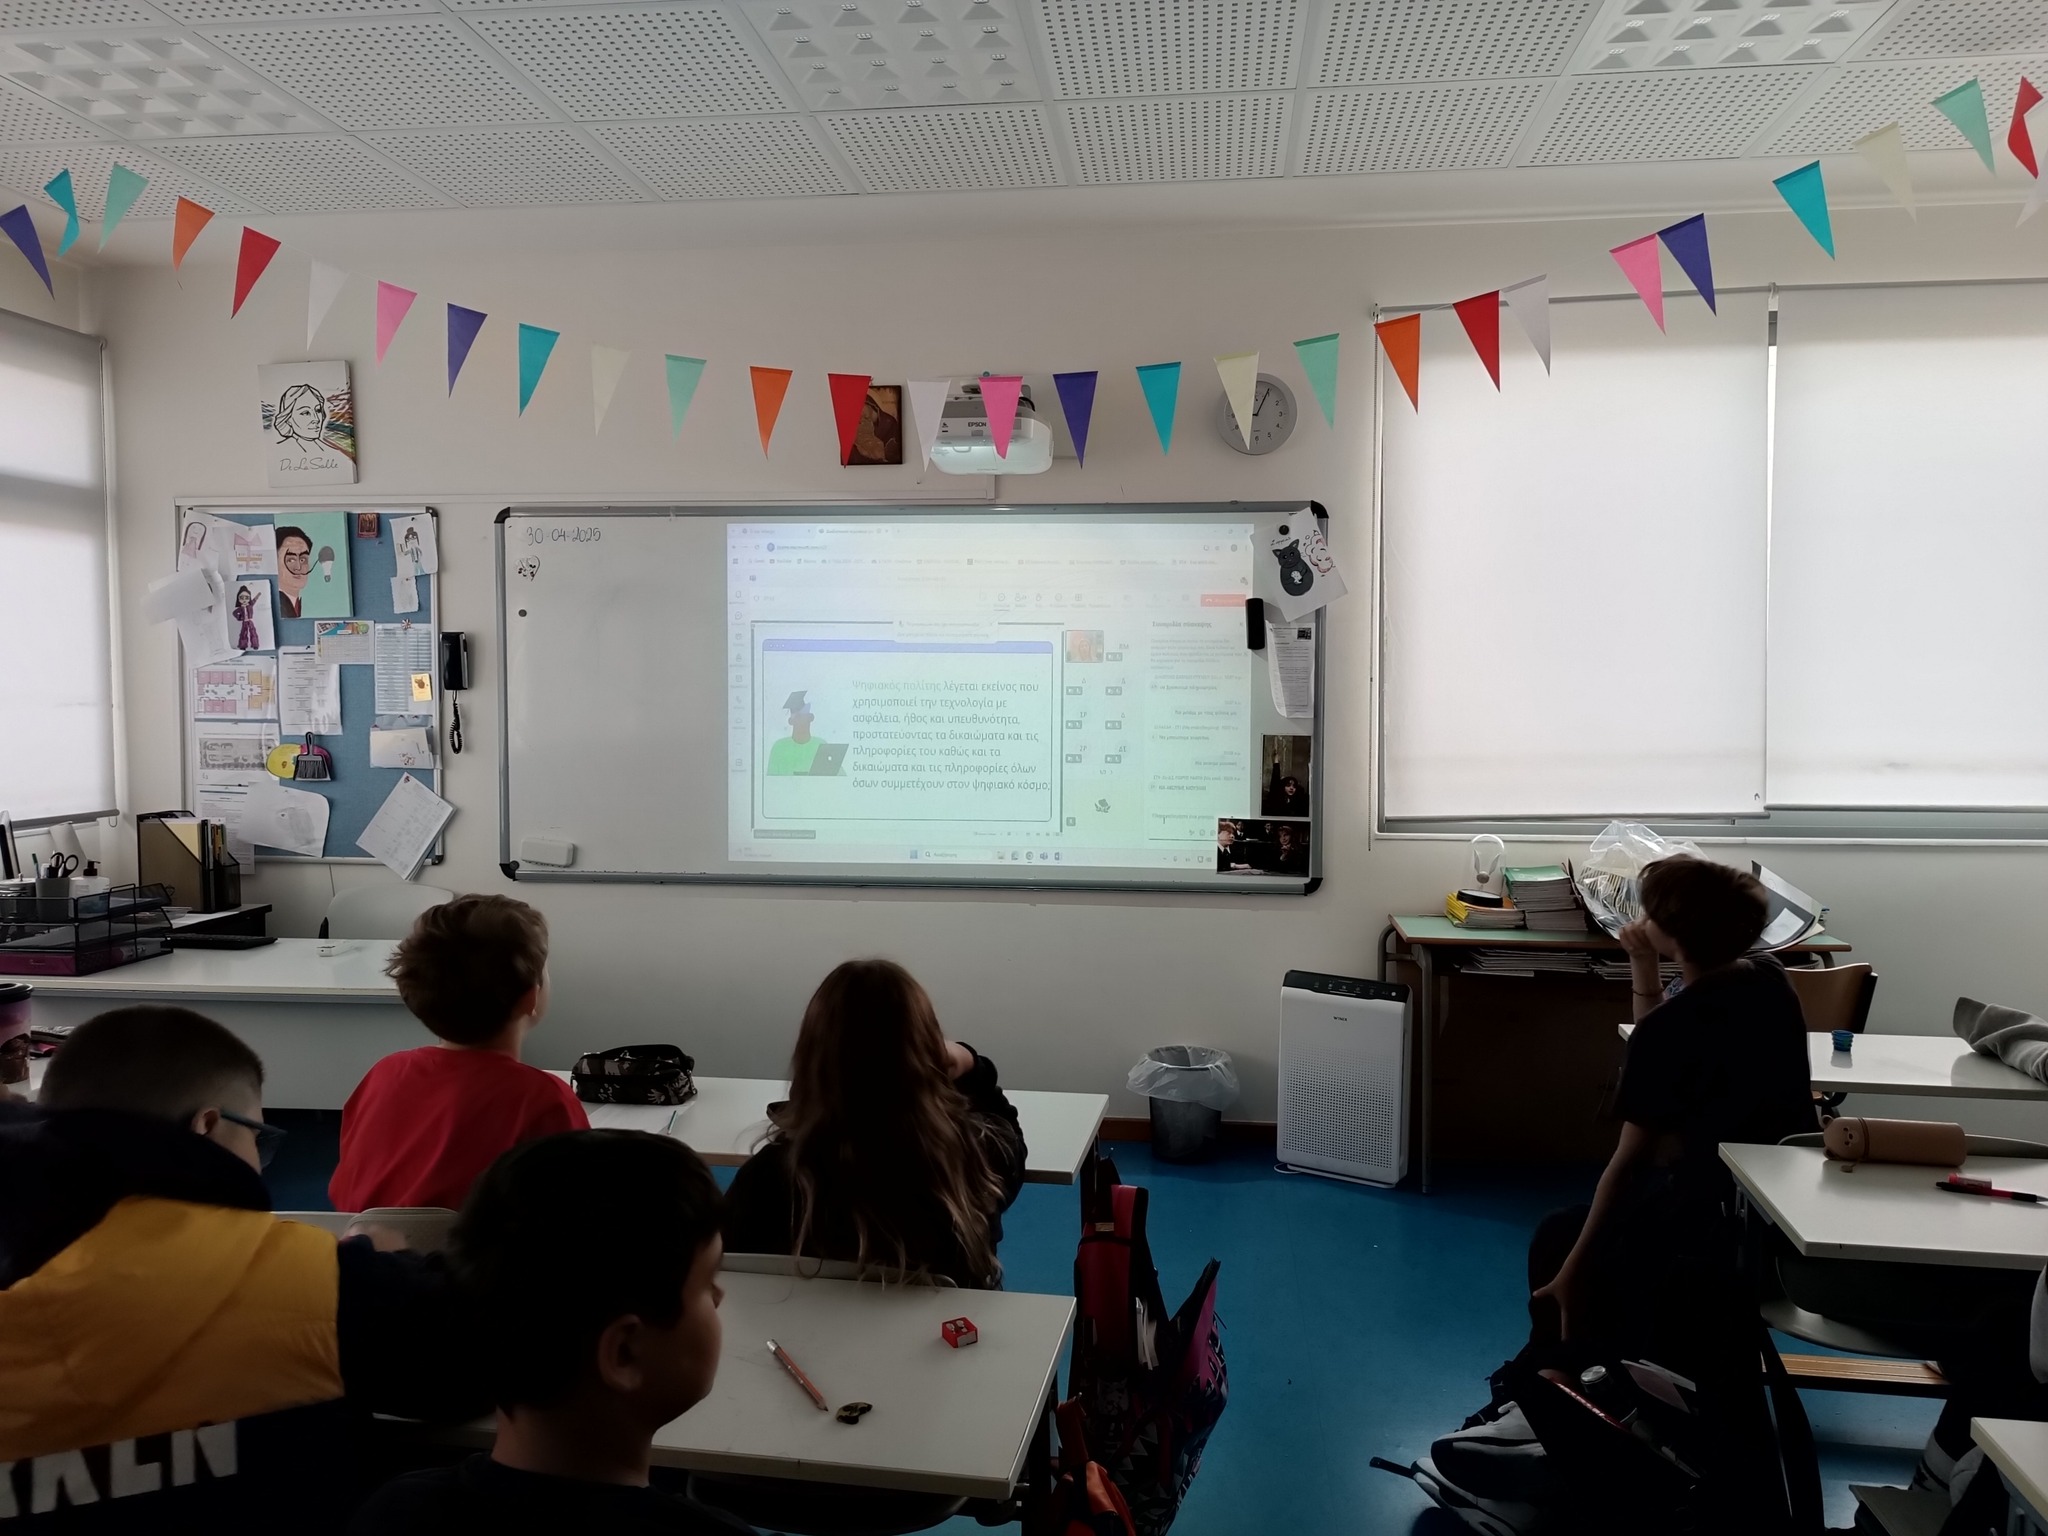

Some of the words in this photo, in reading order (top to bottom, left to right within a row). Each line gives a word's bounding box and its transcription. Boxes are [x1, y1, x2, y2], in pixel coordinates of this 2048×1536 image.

[280, 458, 292, 471] De
[852, 680, 900, 691] Ψηφιακός
[903, 680, 941, 692] πολίτης
[944, 682, 978, 692] λέγεται
[981, 682, 1017, 693] εκείνος
[1020, 684, 1039, 692] που
[852, 697, 917, 708] χρησιμοποιεί
[920, 700, 936, 708] την
[940, 698, 993, 710] τεχνολογία
[996, 700, 1007, 709] με
[904, 713, 927, 724] ήθος
[853, 729, 933, 741] προστατεύοντας
[936, 732, 946, 740] τα
[949, 730, 1005, 742] δικαιώματα
[1008, 732, 1022, 740] και
[1026, 733, 1039, 742] τις
[853, 745, 916, 757] πληροφορίες
[919, 748, 936, 756] του
[939, 746, 969, 757] καθώς
[972, 748, 986, 756] και
[853, 762, 908, 773] δικαιώματα
[911, 764, 925, 772] και
[929, 765, 941, 773] τις
[945, 762, 1008, 774] πληροφορίες
[1011, 763, 1036, 773] όλων
[852, 778, 878, 788] όσων
[881, 779, 944, 791] συμμετέχουν
[947, 780, 970, 789] στον
[972, 779, 1014, 792] ψηφιακό
